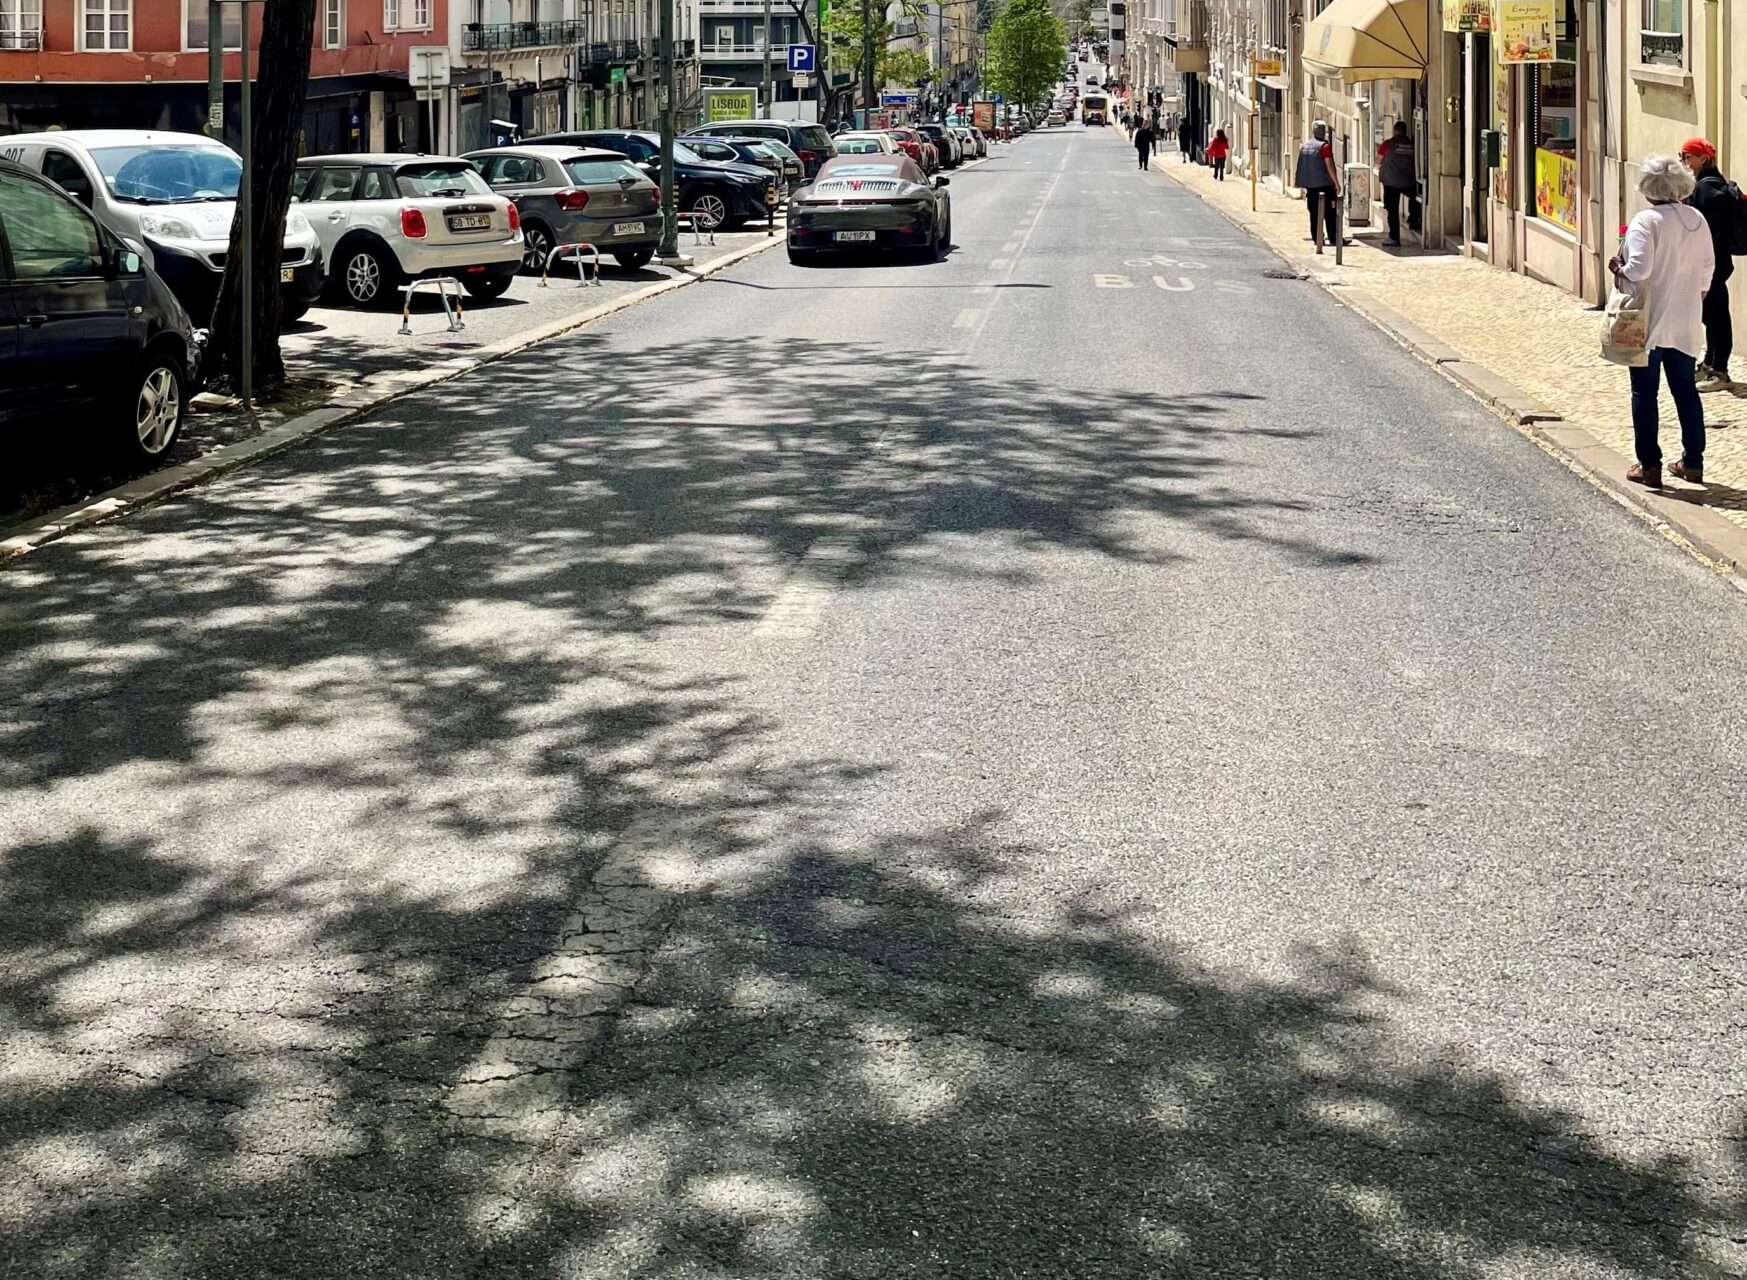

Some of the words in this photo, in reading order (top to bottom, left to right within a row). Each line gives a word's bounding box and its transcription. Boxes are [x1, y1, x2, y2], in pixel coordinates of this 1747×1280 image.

[1511, 4, 1541, 14] Enjoy
[793, 48, 808, 68] P
[712, 98, 748, 110] LISBOA
[497, 135, 505, 146] P
